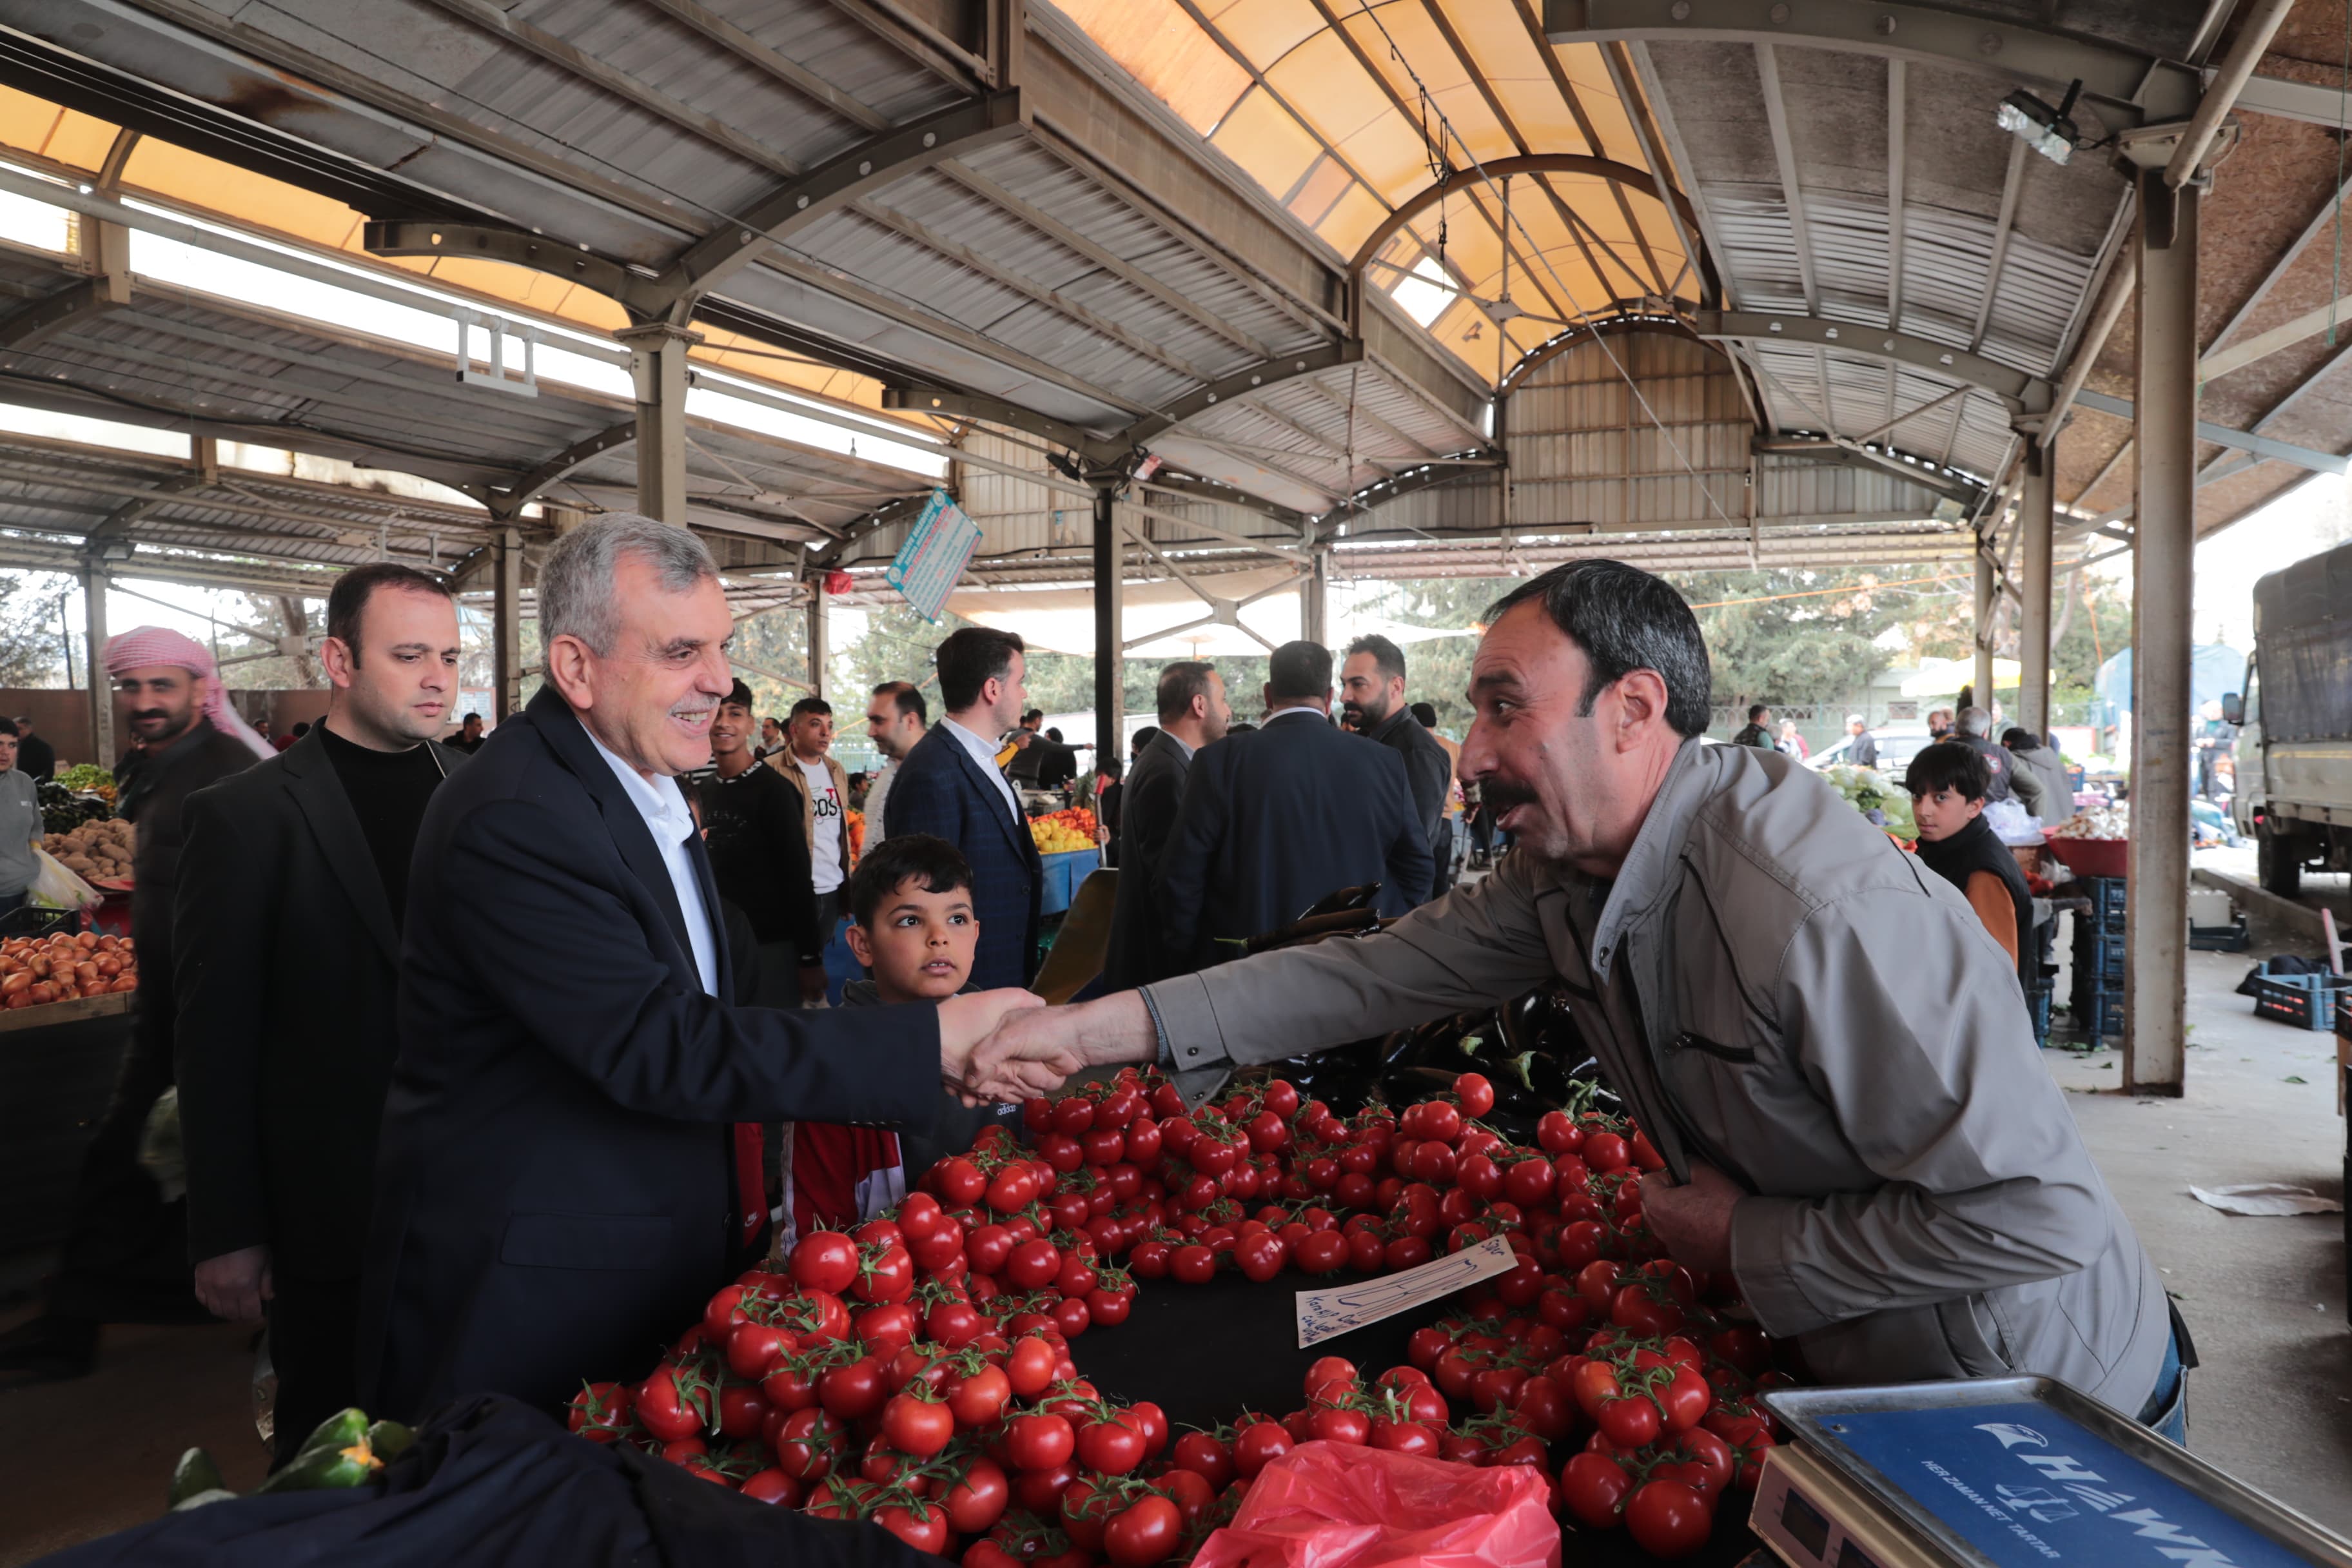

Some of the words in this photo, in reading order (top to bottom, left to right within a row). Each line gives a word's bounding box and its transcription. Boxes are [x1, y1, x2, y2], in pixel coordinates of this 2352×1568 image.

[1921, 1460, 1950, 1477] HER
[1942, 1476, 1989, 1505] ZAMAN
[1981, 1504, 2014, 1522] NET
[2008, 1524, 2061, 1558] TARTAR
